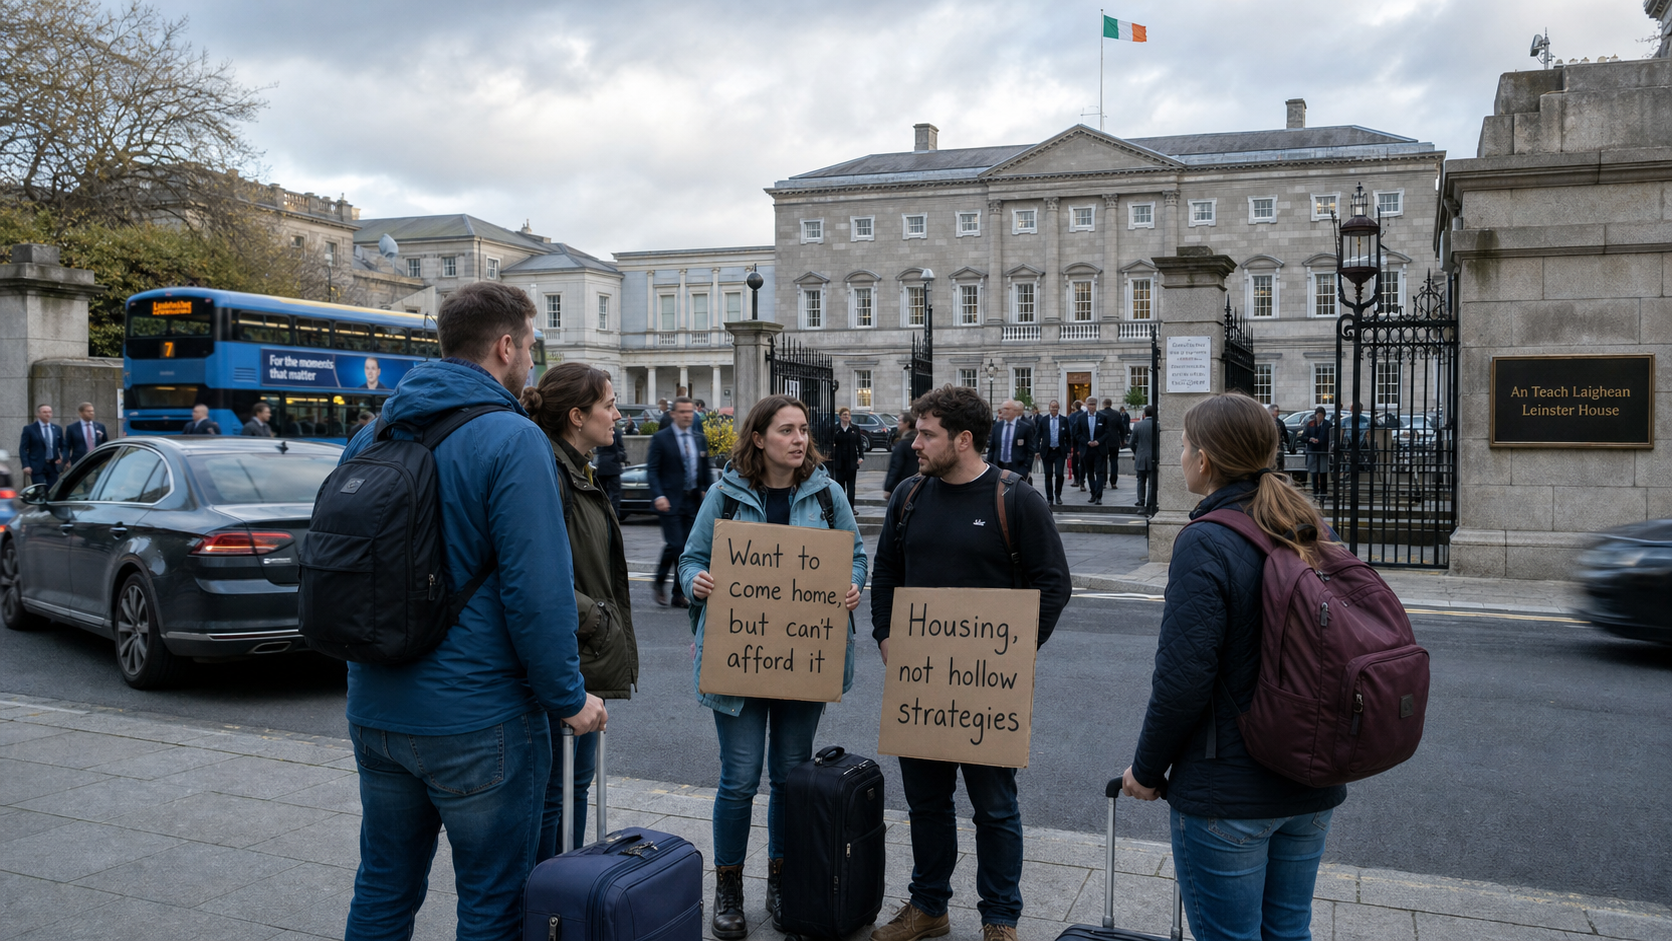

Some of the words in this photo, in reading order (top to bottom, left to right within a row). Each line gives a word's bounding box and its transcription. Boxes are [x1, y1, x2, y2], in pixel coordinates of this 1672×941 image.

[165, 341, 174, 357] 7
[269, 354, 283, 366] For
[284, 355, 298, 367] the
[299, 359, 334, 369] moments
[269, 368, 288, 379] that
[289, 370, 317, 381] matter
[1510, 386, 1528, 398] An
[1531, 386, 1569, 398] Teach
[1572, 385, 1631, 401] Laighean
[1522, 404, 1575, 416] Leinster
[1578, 404, 1620, 416] House
[728, 538, 783, 568] Want
[798, 545, 820, 570] to
[729, 581, 782, 600] come
[792, 578, 842, 608] home,
[729, 608, 769, 636] but
[786, 617, 833, 640] can't
[909, 603, 1018, 655] Housing,
[727, 644, 794, 673] afford
[810, 650, 825, 673] it
[899, 656, 934, 684] not
[949, 657, 1018, 689] hollow
[897, 697, 1019, 745] strategies
